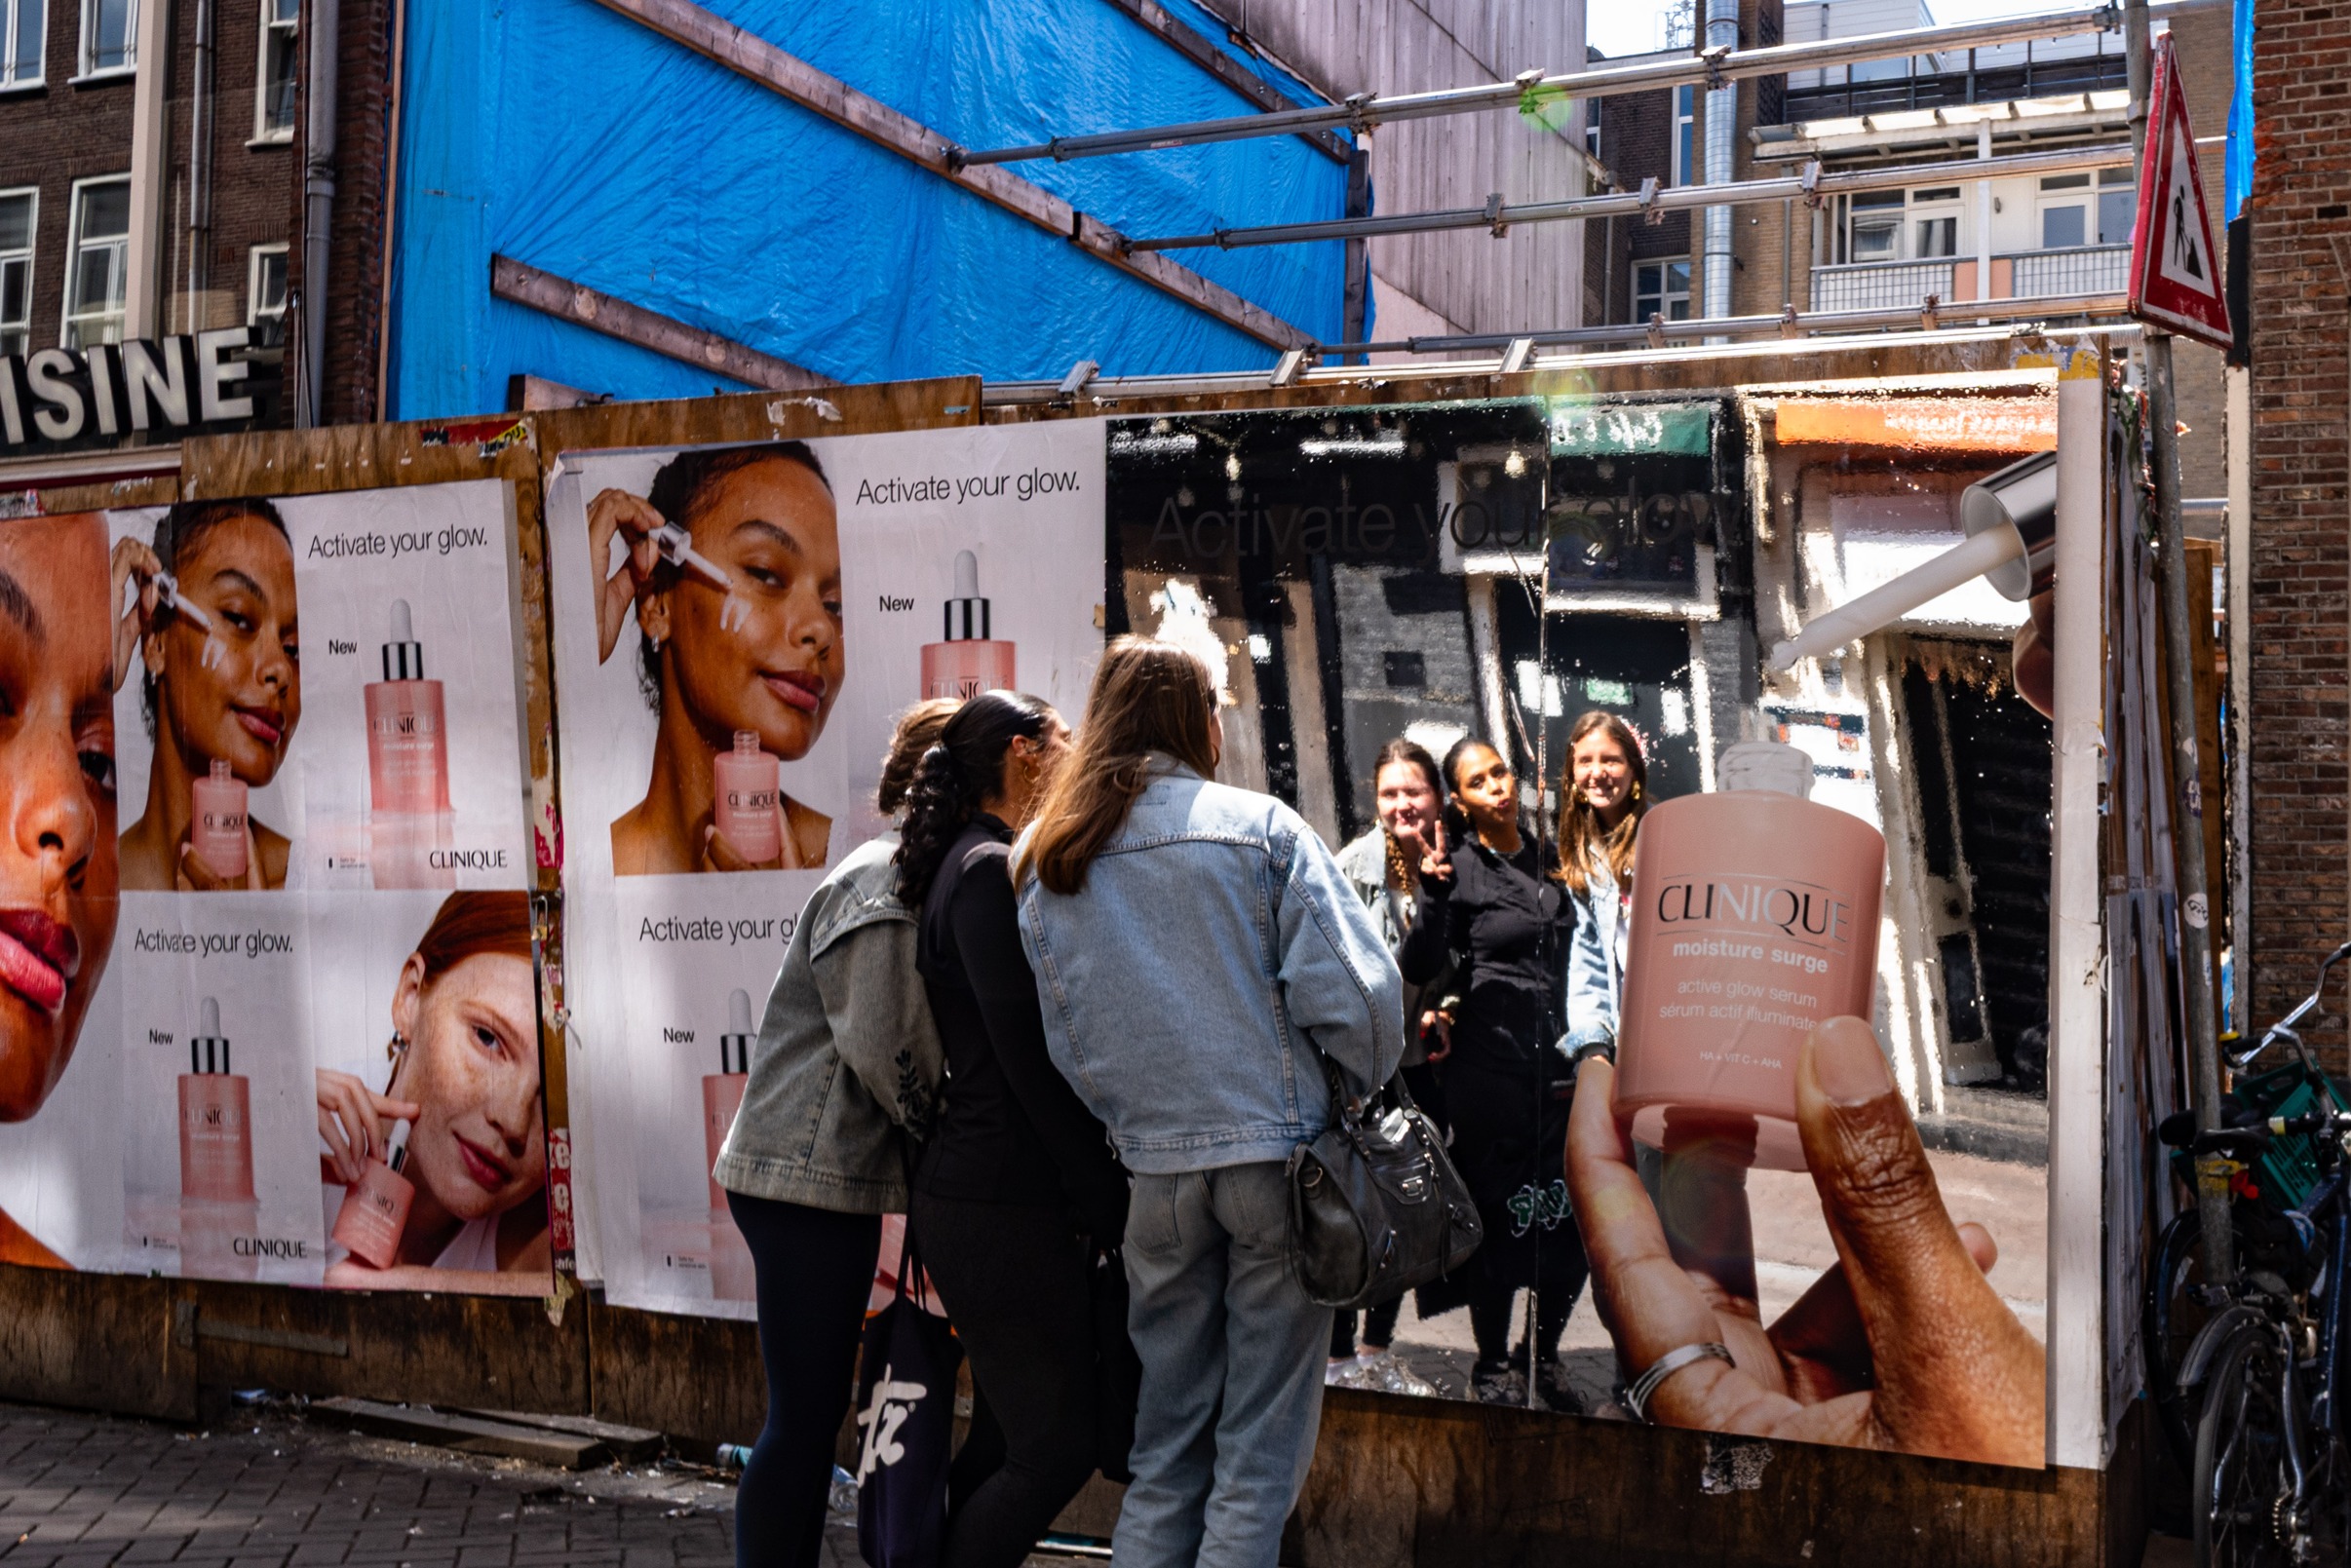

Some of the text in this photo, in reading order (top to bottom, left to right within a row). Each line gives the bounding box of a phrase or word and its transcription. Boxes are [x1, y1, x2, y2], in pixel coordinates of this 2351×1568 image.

[856, 467, 1080, 505] Activate your glow.
[308, 523, 487, 559] Activate your glow.
[1147, 492, 1396, 558] Activate
[1413, 499, 1560, 566] your
[879, 595, 914, 612] New
[328, 639, 358, 656] New
[429, 850, 508, 871] CLINIQUE
[1658, 882, 1850, 942] CLINIQUE
[201, 933, 241, 959] your
[246, 929, 293, 959] glow.
[639, 916, 723, 942] Activate
[728, 919, 775, 946] your
[1673, 938, 1829, 974] moisture surge
[1677, 978, 1817, 1009] active glow serum
[1660, 1000, 1705, 1018] sérum
[1710, 1004, 1745, 1019] actif
[149, 1028, 173, 1046] New
[664, 1027, 695, 1043] New
[233, 1237, 308, 1260] CLINIQUE
